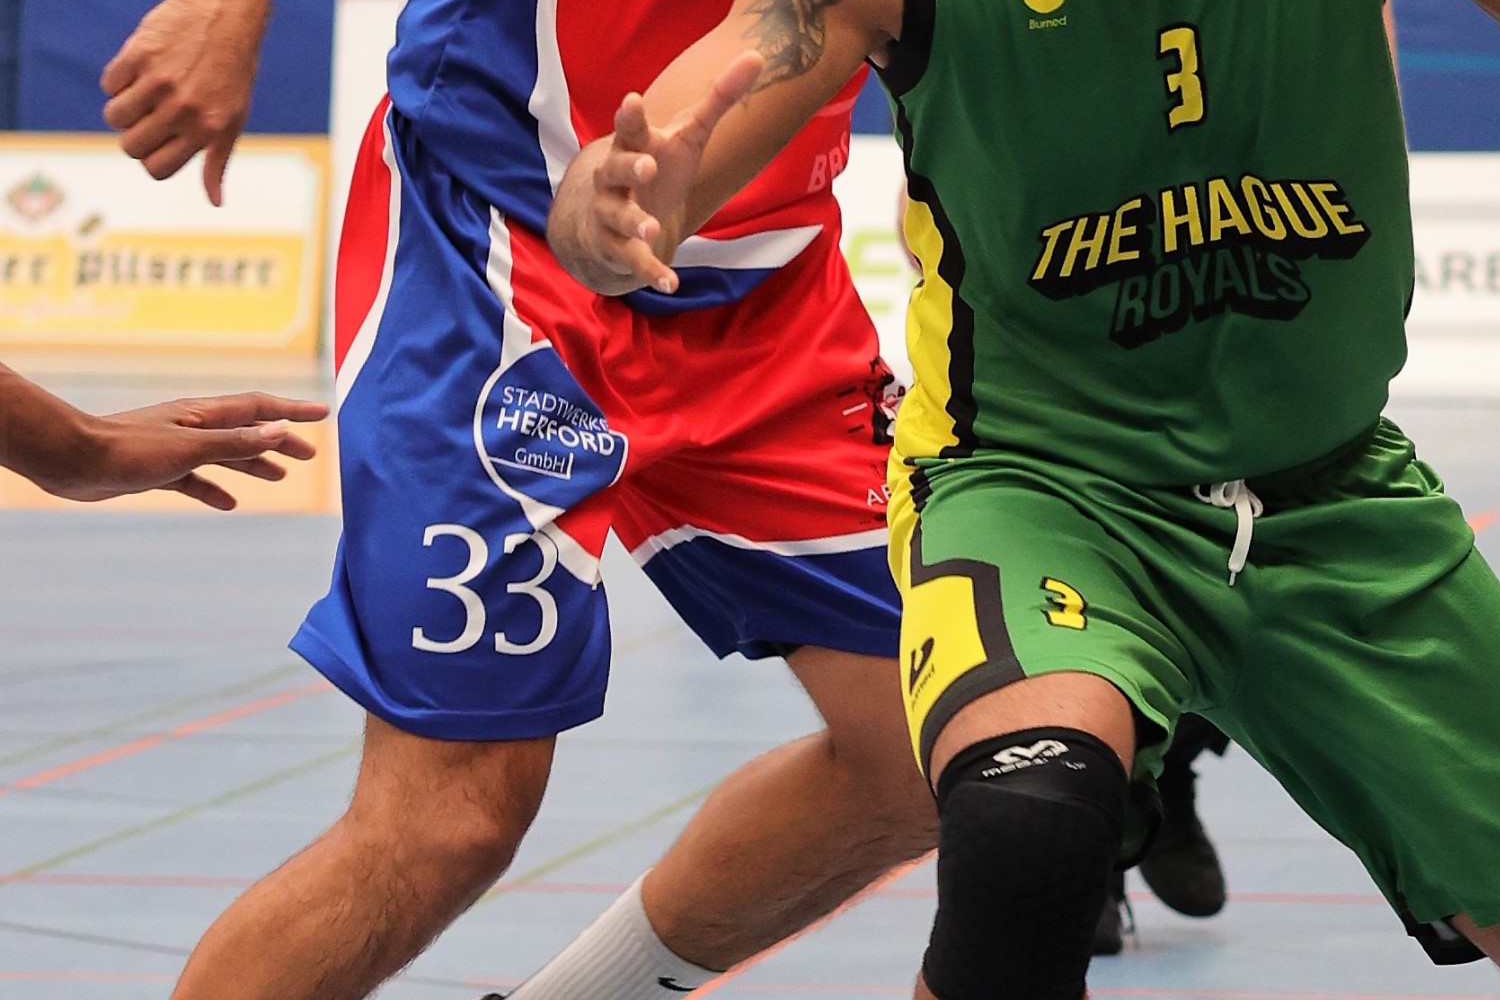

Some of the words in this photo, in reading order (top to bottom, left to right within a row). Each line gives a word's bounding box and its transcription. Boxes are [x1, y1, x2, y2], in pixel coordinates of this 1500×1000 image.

[1028, 15, 1068, 31] Burned
[1159, 26, 1205, 130] 3
[1030, 197, 1142, 281] THE
[1160, 175, 1366, 253] HAGUE
[1113, 248, 1308, 335] ROYALS
[497, 407, 615, 456] HERFORD
[503, 386, 608, 431] STADTWERKE
[515, 447, 566, 474] GmbH
[412, 524, 560, 655] 33
[1040, 576, 1087, 630] 3
